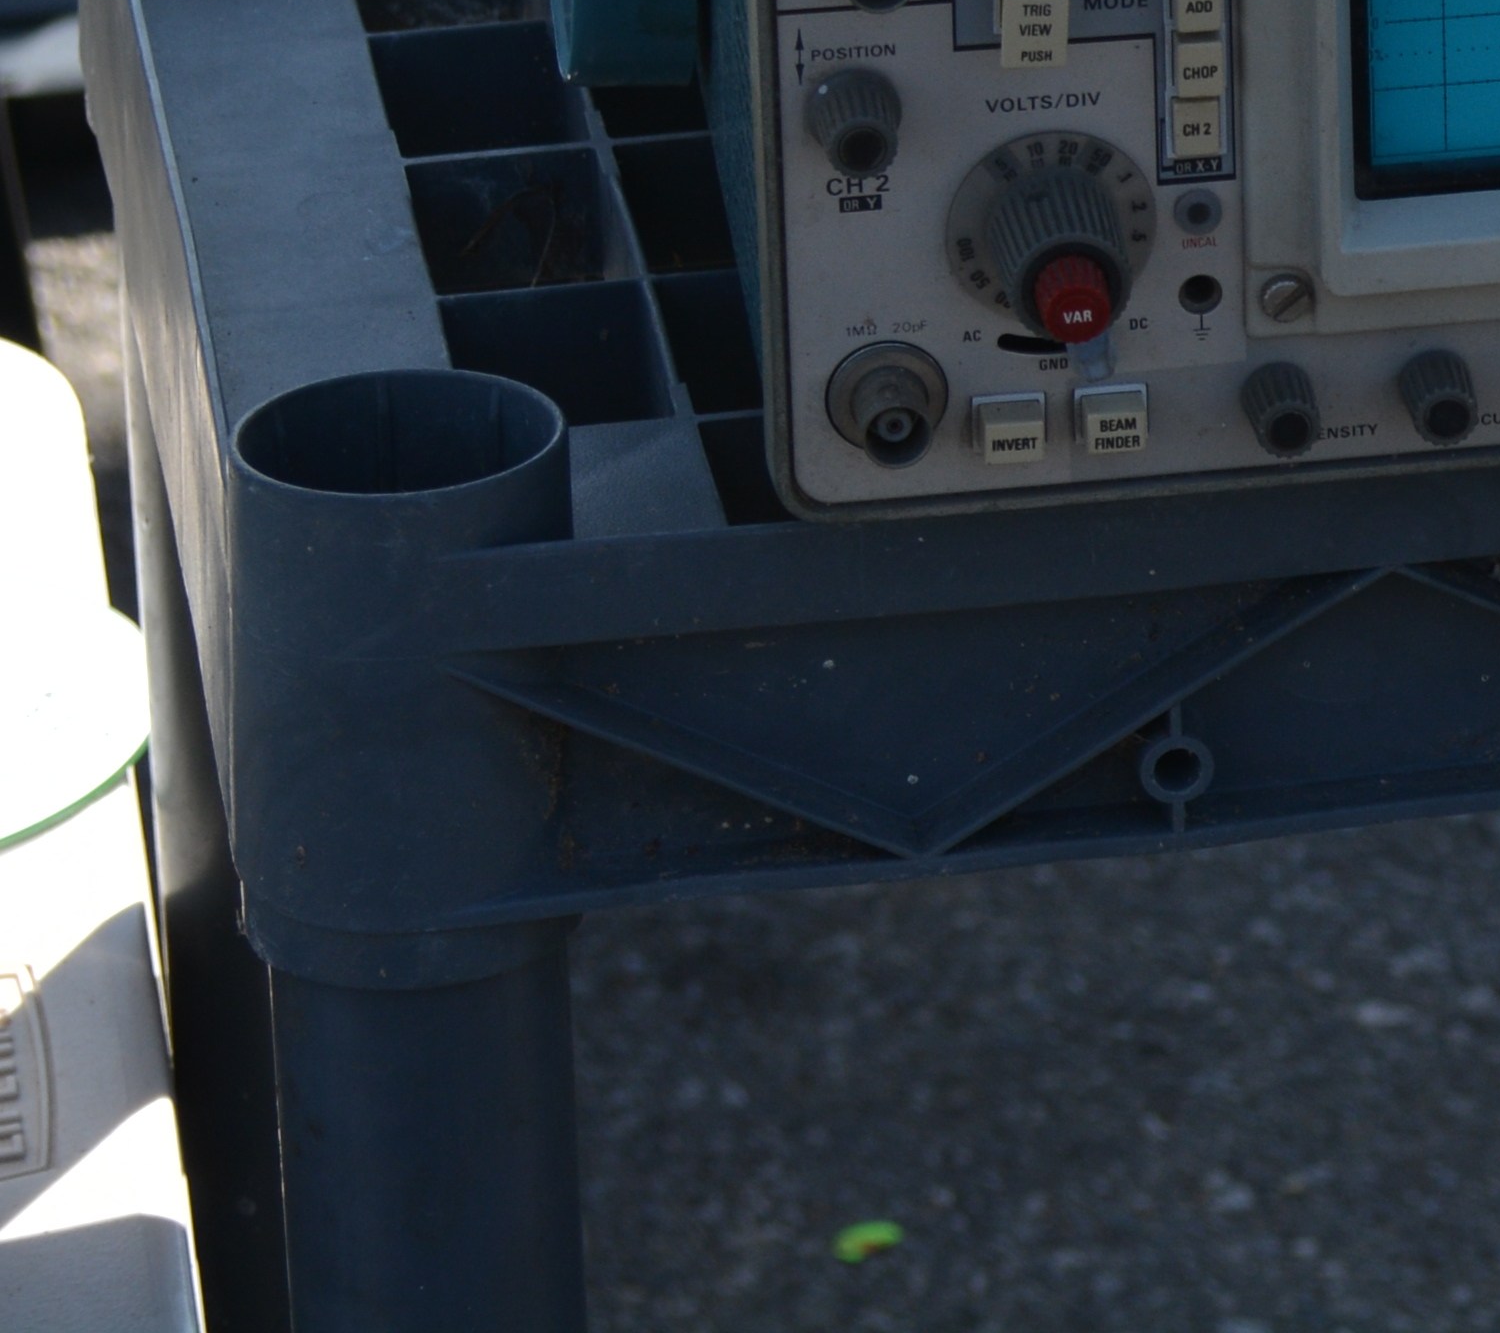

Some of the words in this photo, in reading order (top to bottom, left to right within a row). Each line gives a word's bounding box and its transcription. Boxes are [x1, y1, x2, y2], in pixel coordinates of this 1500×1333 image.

[1023, 4, 1051, 17] TRIG
[1019, 23, 1052, 37] VIEW
[811, 43, 896, 61] POSITION
[1021, 50, 1052, 63] PUSH
[1183, 65, 1218, 80] CHOP
[985, 92, 1101, 113] VOLTS/DIV
[1182, 236, 1218, 249] UNCAL
[1063, 309, 1092, 324] VAR
[1039, 357, 1068, 371] GND
[1100, 418, 1137, 432] BEAM
[992, 437, 1038, 452] INVERT
[1095, 435, 1141, 449] FINDER
